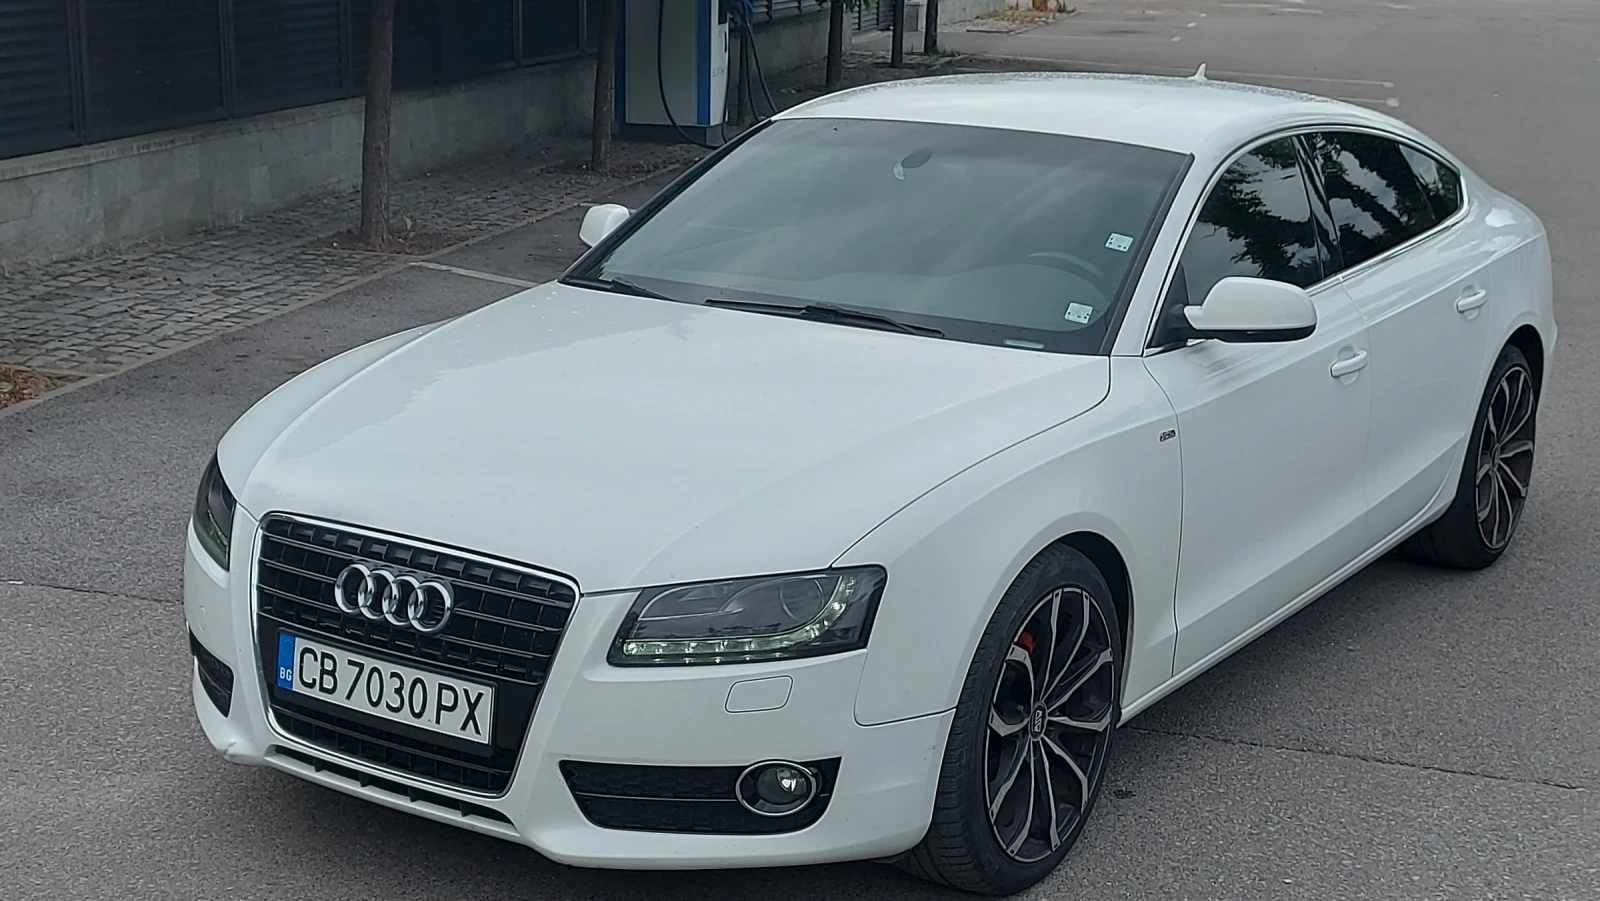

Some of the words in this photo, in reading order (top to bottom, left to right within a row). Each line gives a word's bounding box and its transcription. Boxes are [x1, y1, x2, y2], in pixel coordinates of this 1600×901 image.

[279, 666, 292, 681] BG
[298, 646, 338, 695] CB
[345, 659, 428, 720] 7030
[435, 681, 484, 736] PX
